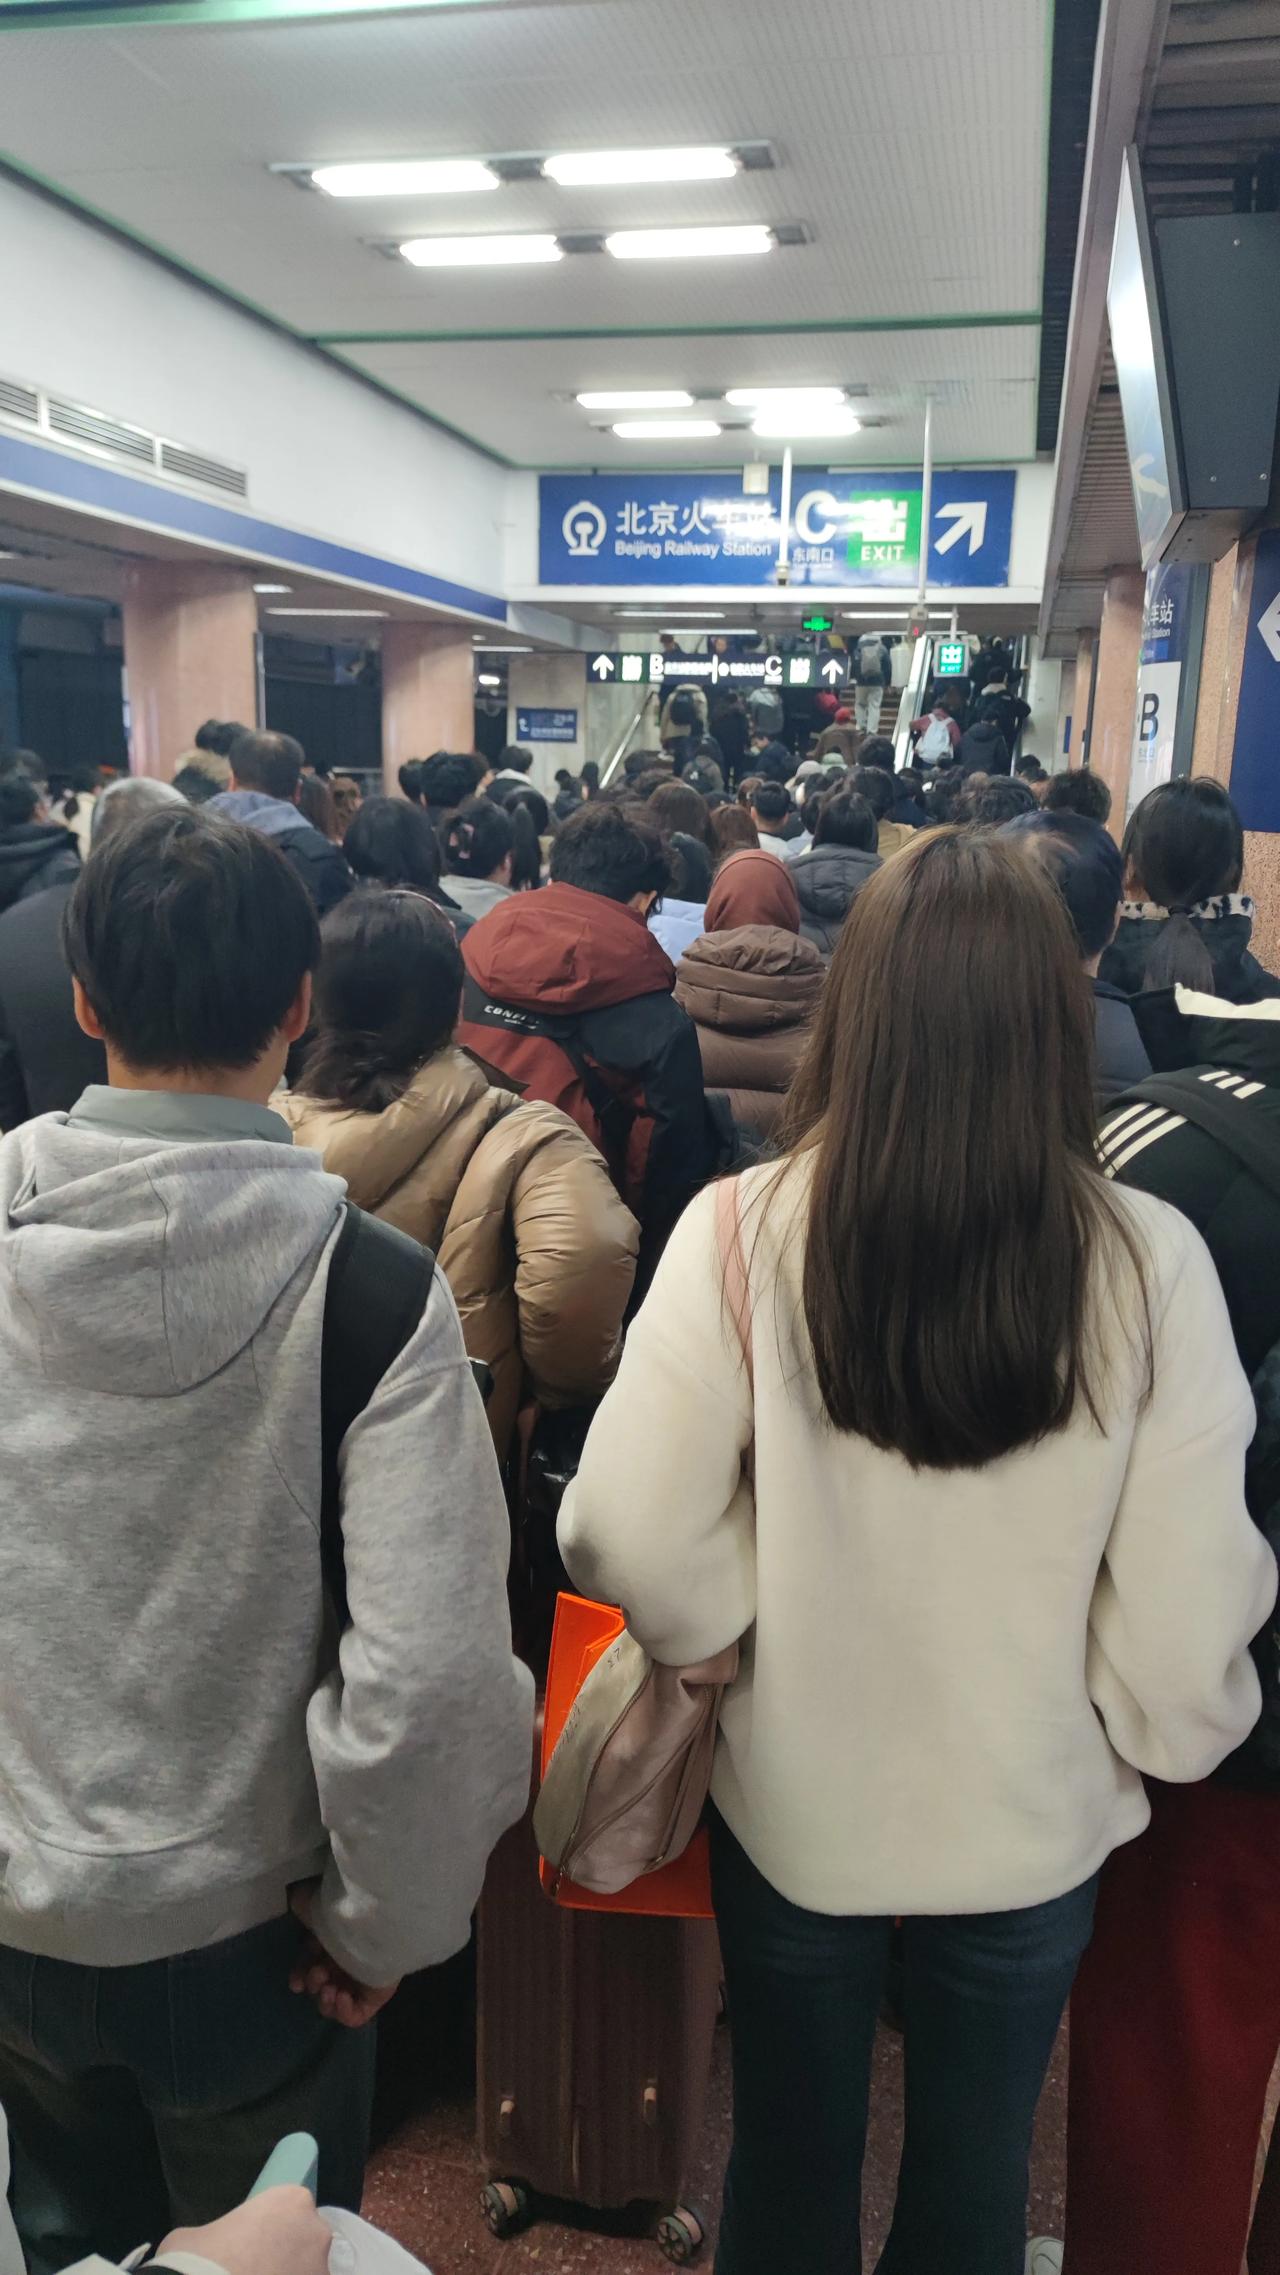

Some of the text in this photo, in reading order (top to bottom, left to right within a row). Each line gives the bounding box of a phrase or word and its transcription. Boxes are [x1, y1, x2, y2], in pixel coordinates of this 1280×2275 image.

[616, 500, 778, 537] 北京火
[795, 489, 838, 545] C
[614, 540, 772, 560] Beijing Railway Station
[861, 545, 905, 561] EXIT
[650, 653, 665, 676] B
[765, 655, 783, 677] C
[1139, 692, 1160, 742] B
